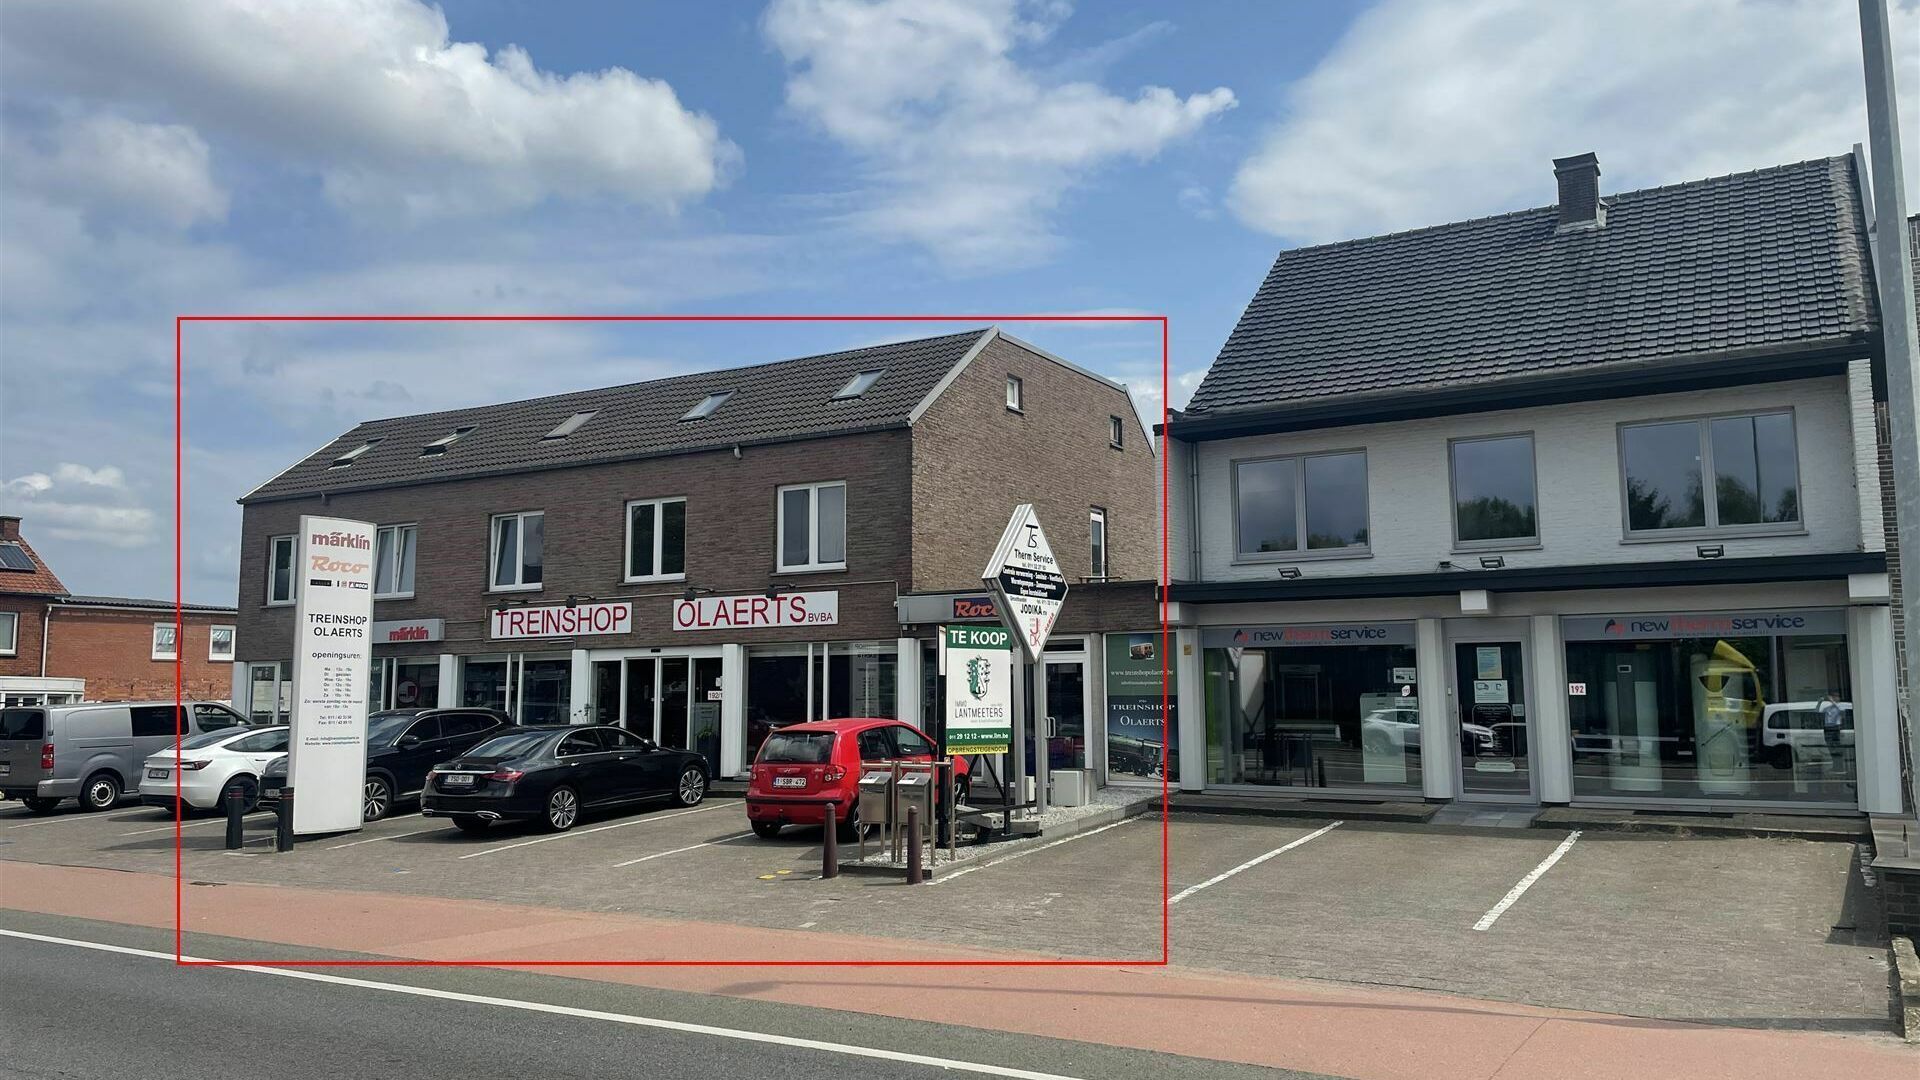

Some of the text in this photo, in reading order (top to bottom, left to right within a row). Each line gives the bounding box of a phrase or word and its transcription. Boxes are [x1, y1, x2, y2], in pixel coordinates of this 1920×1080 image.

[311, 531, 370, 550] märklin
[311, 555, 369, 573] Roco
[1014, 549, 1054, 565] Therm Service
[308, 613, 368, 625] TREINSHOP
[677, 595, 834, 628] OLAERTS BVBA
[495, 605, 628, 636] TREINSHOP
[313, 626, 363, 638] OLAERTS
[388, 625, 429, 641] märklin
[950, 630, 1008, 646] TE KOOP
[1570, 685, 1584, 694] 192
[954, 707, 1004, 719] LANTMEETERS
